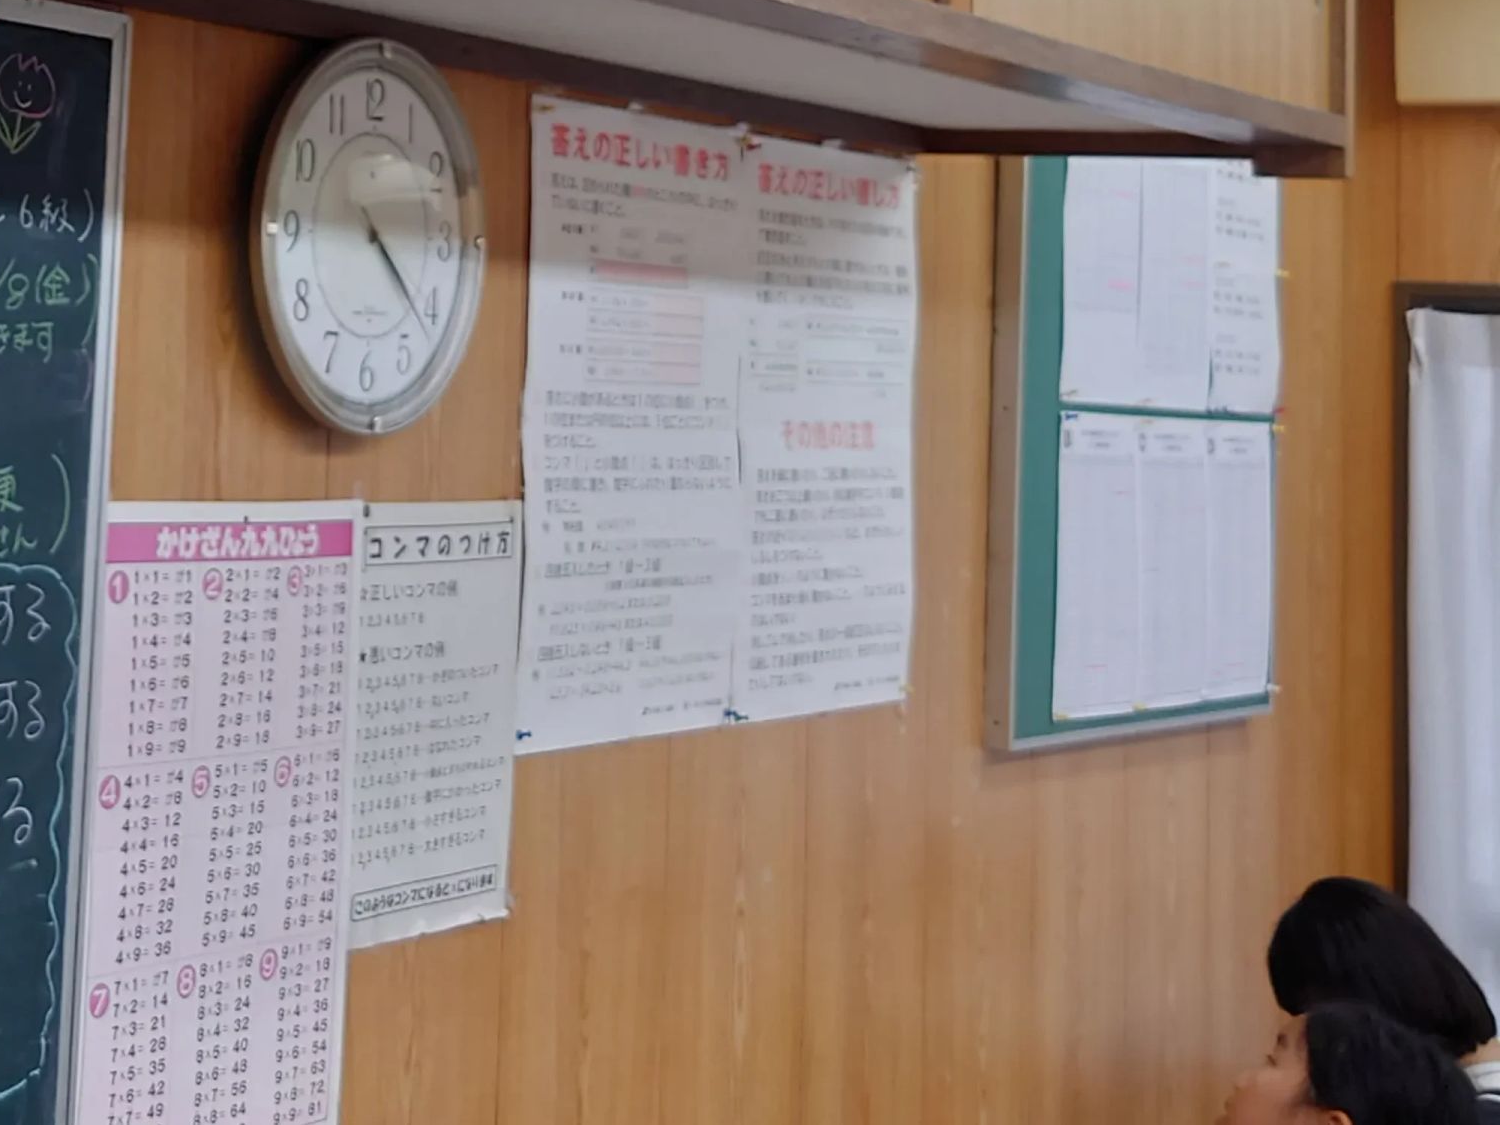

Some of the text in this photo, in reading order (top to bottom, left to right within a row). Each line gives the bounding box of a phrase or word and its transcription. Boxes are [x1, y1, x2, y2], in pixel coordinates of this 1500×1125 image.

[329, 92, 345, 135] 11
[366, 78, 385, 122] 12
[296, 138, 316, 182] 10
[429, 150, 444, 192] 2
[283, 208, 300, 253] 9
[437, 219, 451, 262] 3
[293, 277, 310, 322] 8
[423, 286, 439, 325] 4
[323, 330, 340, 374] 7
[358, 350, 375, 392] 6
[396, 333, 412, 376] 5
[369, 531, 510, 559] コンマのつけ方
